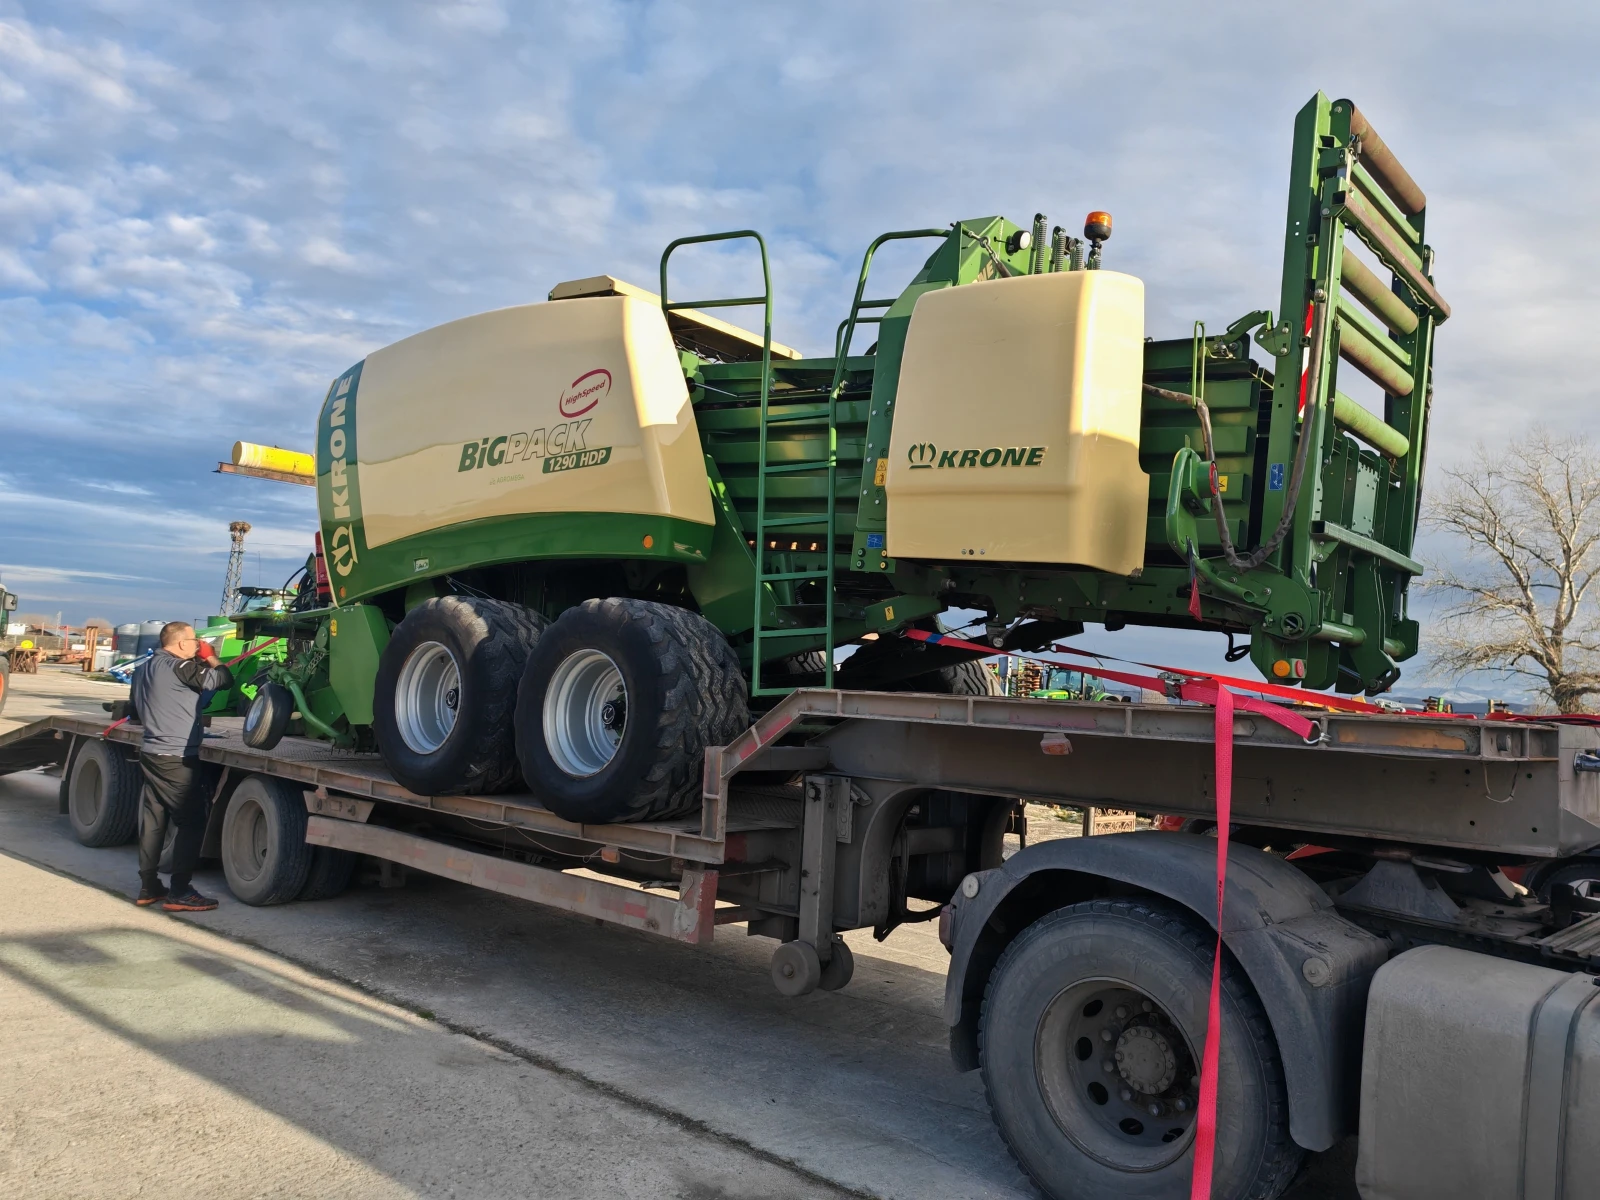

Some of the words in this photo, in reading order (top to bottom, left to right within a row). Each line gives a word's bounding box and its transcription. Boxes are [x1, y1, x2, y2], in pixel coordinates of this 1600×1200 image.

[565, 379, 606, 406] HighSpeed
[330, 374, 353, 519] KRONE
[937, 446, 1048, 468] KRONE
[549, 454, 577, 471] 1290
[579, 450, 607, 467] HDP
